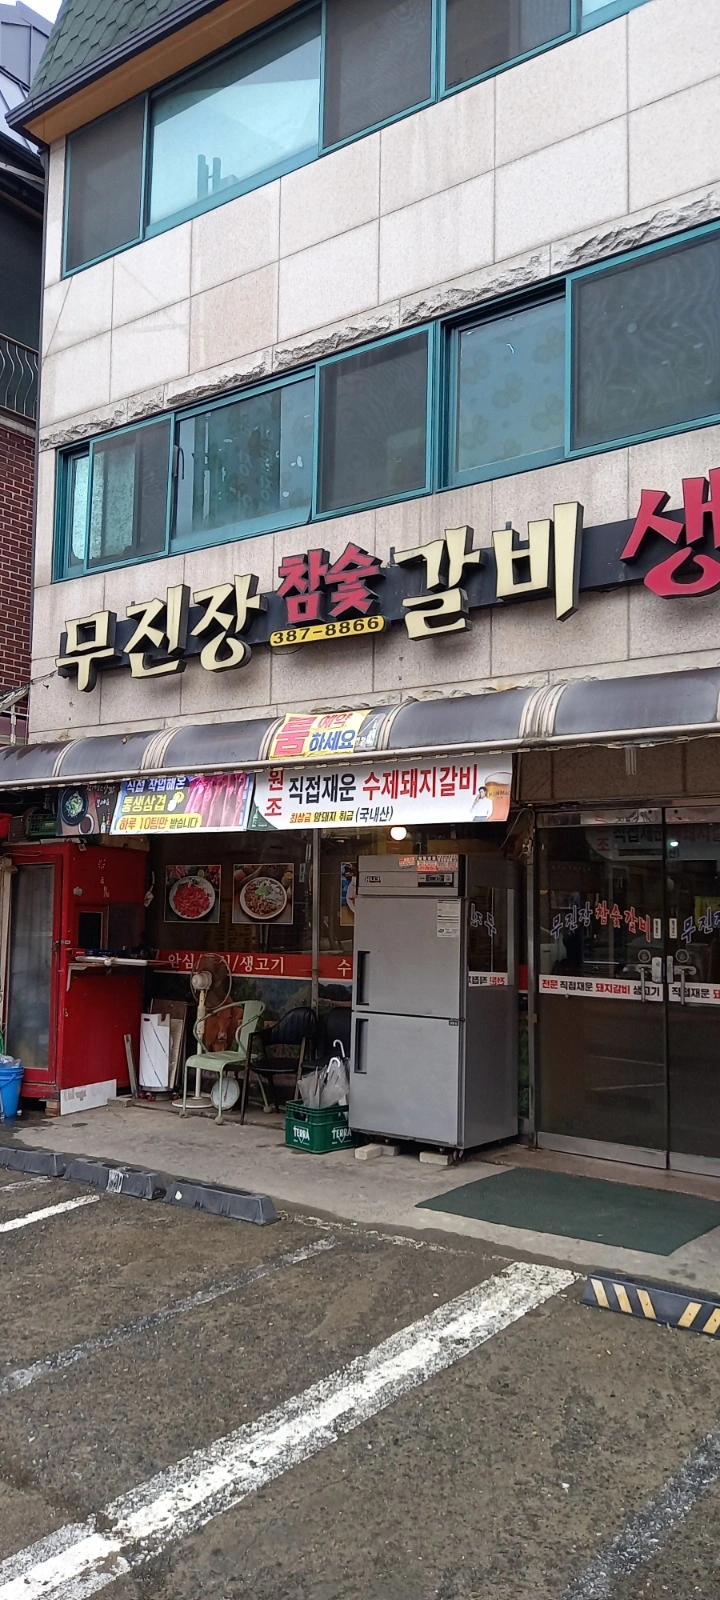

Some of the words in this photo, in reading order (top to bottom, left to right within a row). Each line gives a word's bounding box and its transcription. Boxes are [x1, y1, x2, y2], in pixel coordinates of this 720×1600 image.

[58, 574, 262, 692] 무진장
[618, 466, 720, 600] 생
[271, 616, 381, 646] 387-8866
[273, 716, 317, 756] 룸
[309, 730, 356, 752] 하세요
[288, 772, 356, 805] 직접재운
[362, 764, 478, 801] 수제돼지갈비
[121, 794, 167, 813] 통생삼겹
[119, 816, 137, 831] 하루
[139, 815, 168, 830] 10팀만
[169, 816, 198, 830] 받습니다
[313, 810, 336, 823] 암돼지
[338, 809, 354, 822] 취급
[355, 805, 394, 823] (국내산)
[550, 901, 593, 939] 무진장
[594, 900, 651, 943] 참숯갈비
[542, 979, 558, 990] 전문
[560, 981, 593, 992] 직접재운
[596, 984, 631, 995] 돼지갈비
[633, 985, 660, 997] 생고기
[293, 1126, 310, 1141] TERRA
[332, 1126, 352, 1140] TERRA
